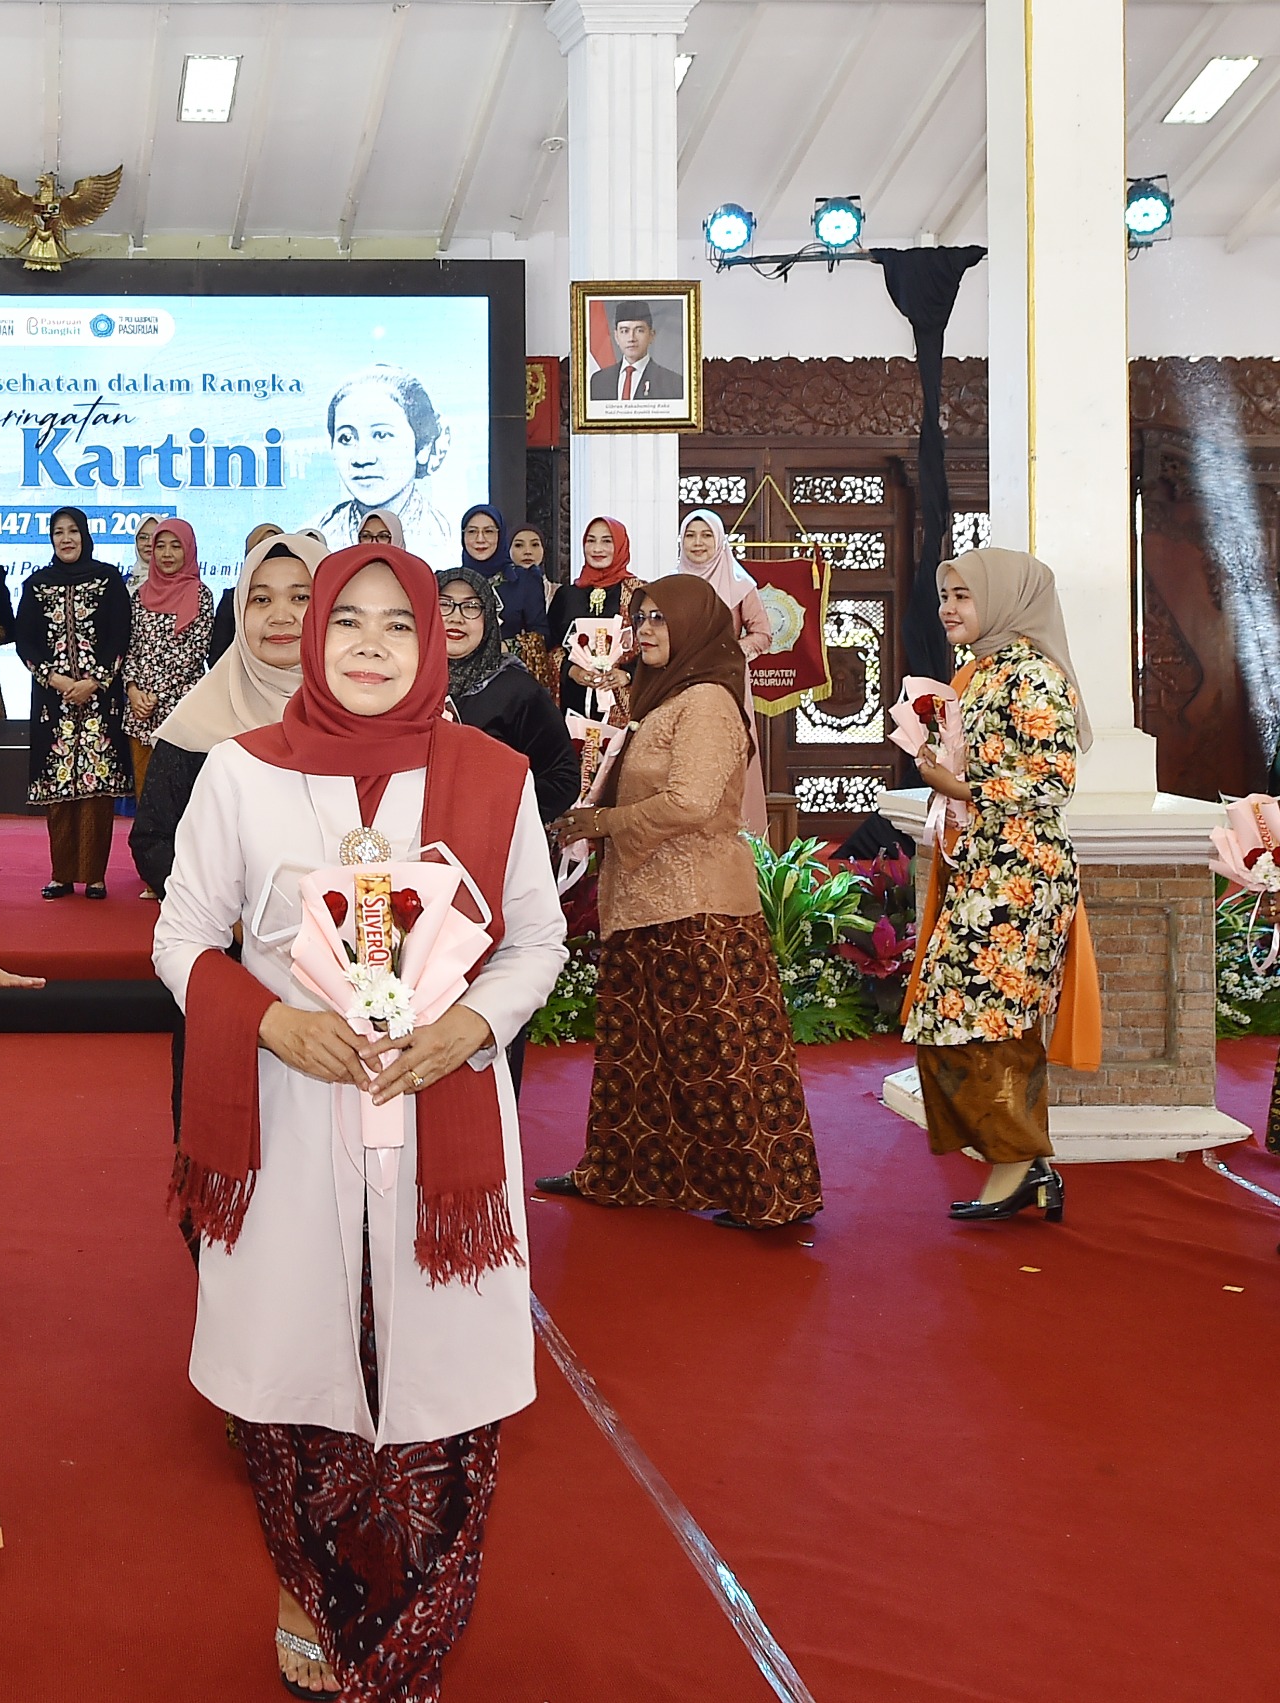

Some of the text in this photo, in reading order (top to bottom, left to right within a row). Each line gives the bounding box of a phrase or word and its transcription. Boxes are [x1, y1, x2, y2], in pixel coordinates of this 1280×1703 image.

[40, 318, 82, 326] Pasuruan
[41, 326, 81, 336] Bangkit
[119, 324, 158, 335] PASURUAN
[108, 373, 191, 393] dalam
[202, 373, 303, 399] Rangka
[20, 427, 284, 488] Kartini
